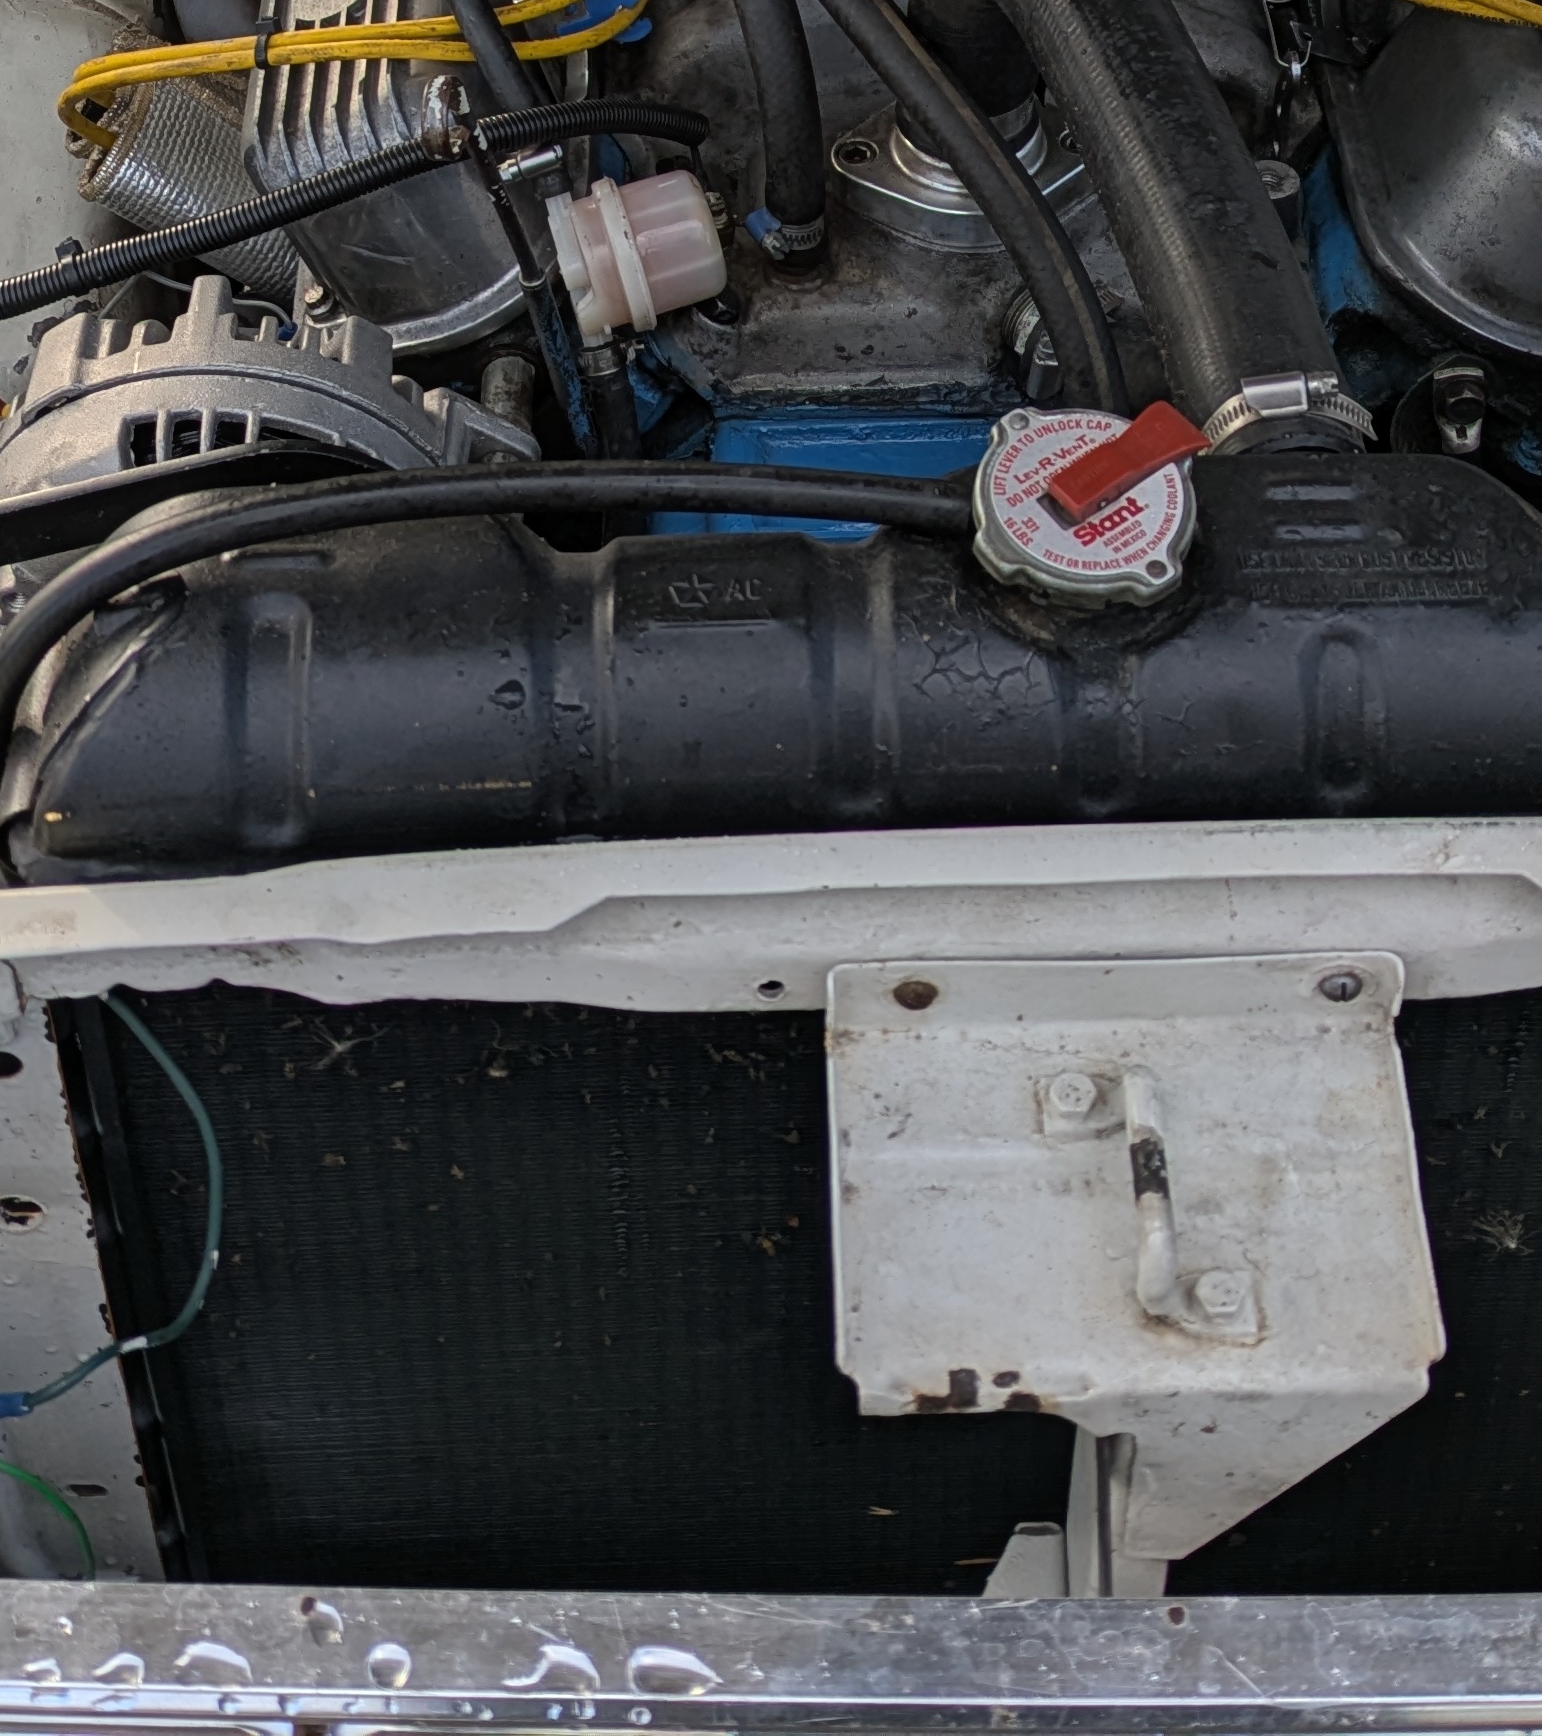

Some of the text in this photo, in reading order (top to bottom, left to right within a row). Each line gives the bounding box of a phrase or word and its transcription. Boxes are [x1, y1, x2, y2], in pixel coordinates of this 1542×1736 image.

[994, 419, 1112, 496] LIFT LEVER TO UNLOCK CAP
[1006, 493, 1024, 507] DO
[1021, 480, 1047, 499] NOT
[1003, 516, 1018, 530] 16
[1043, 472, 1179, 571] TEST OR REPLACE WHEN CHANGING COOLANT
[1073, 496, 1146, 548] Stant
[1103, 520, 1143, 548] ASSEMBLED
[1112, 529, 1148, 554] IN MEXICO
